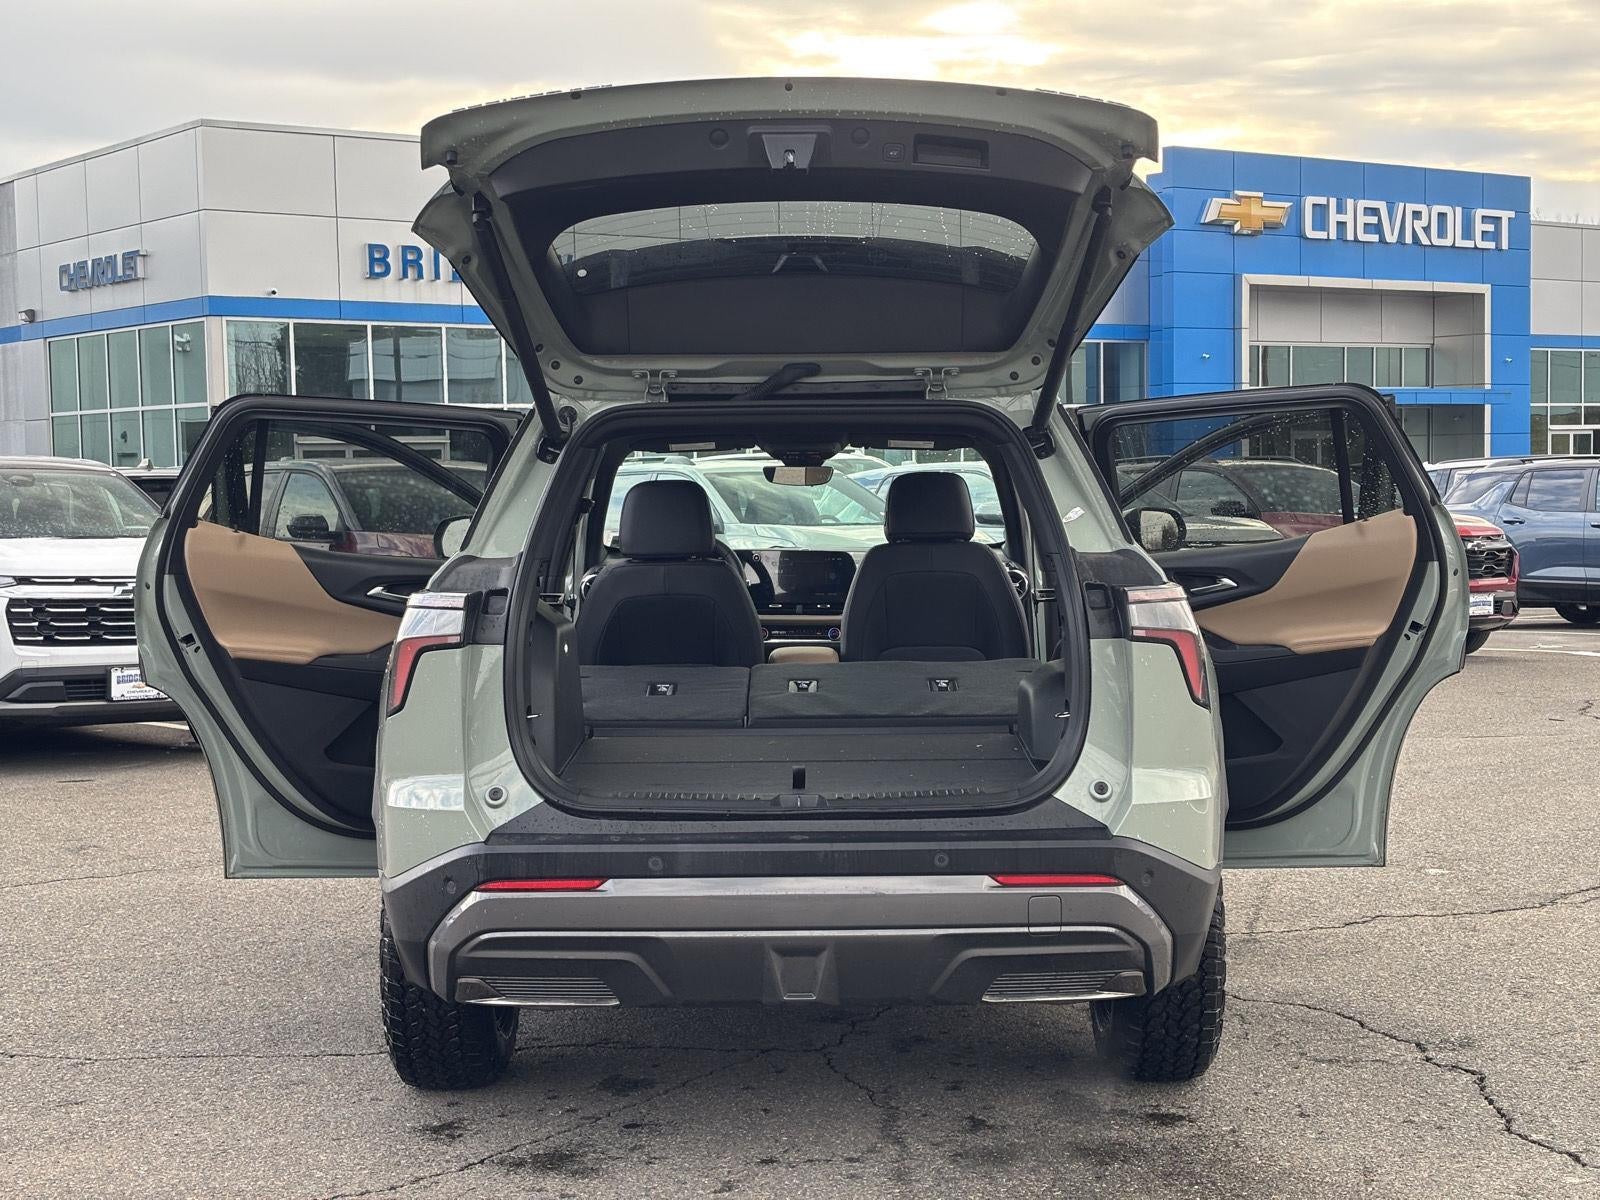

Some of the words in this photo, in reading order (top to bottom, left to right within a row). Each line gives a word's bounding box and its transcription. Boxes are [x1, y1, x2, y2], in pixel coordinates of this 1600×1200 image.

[1303, 195, 1516, 250] CHEVROLET
[58, 249, 147, 292] CHEVROLET
[364, 243, 462, 284] BRI
